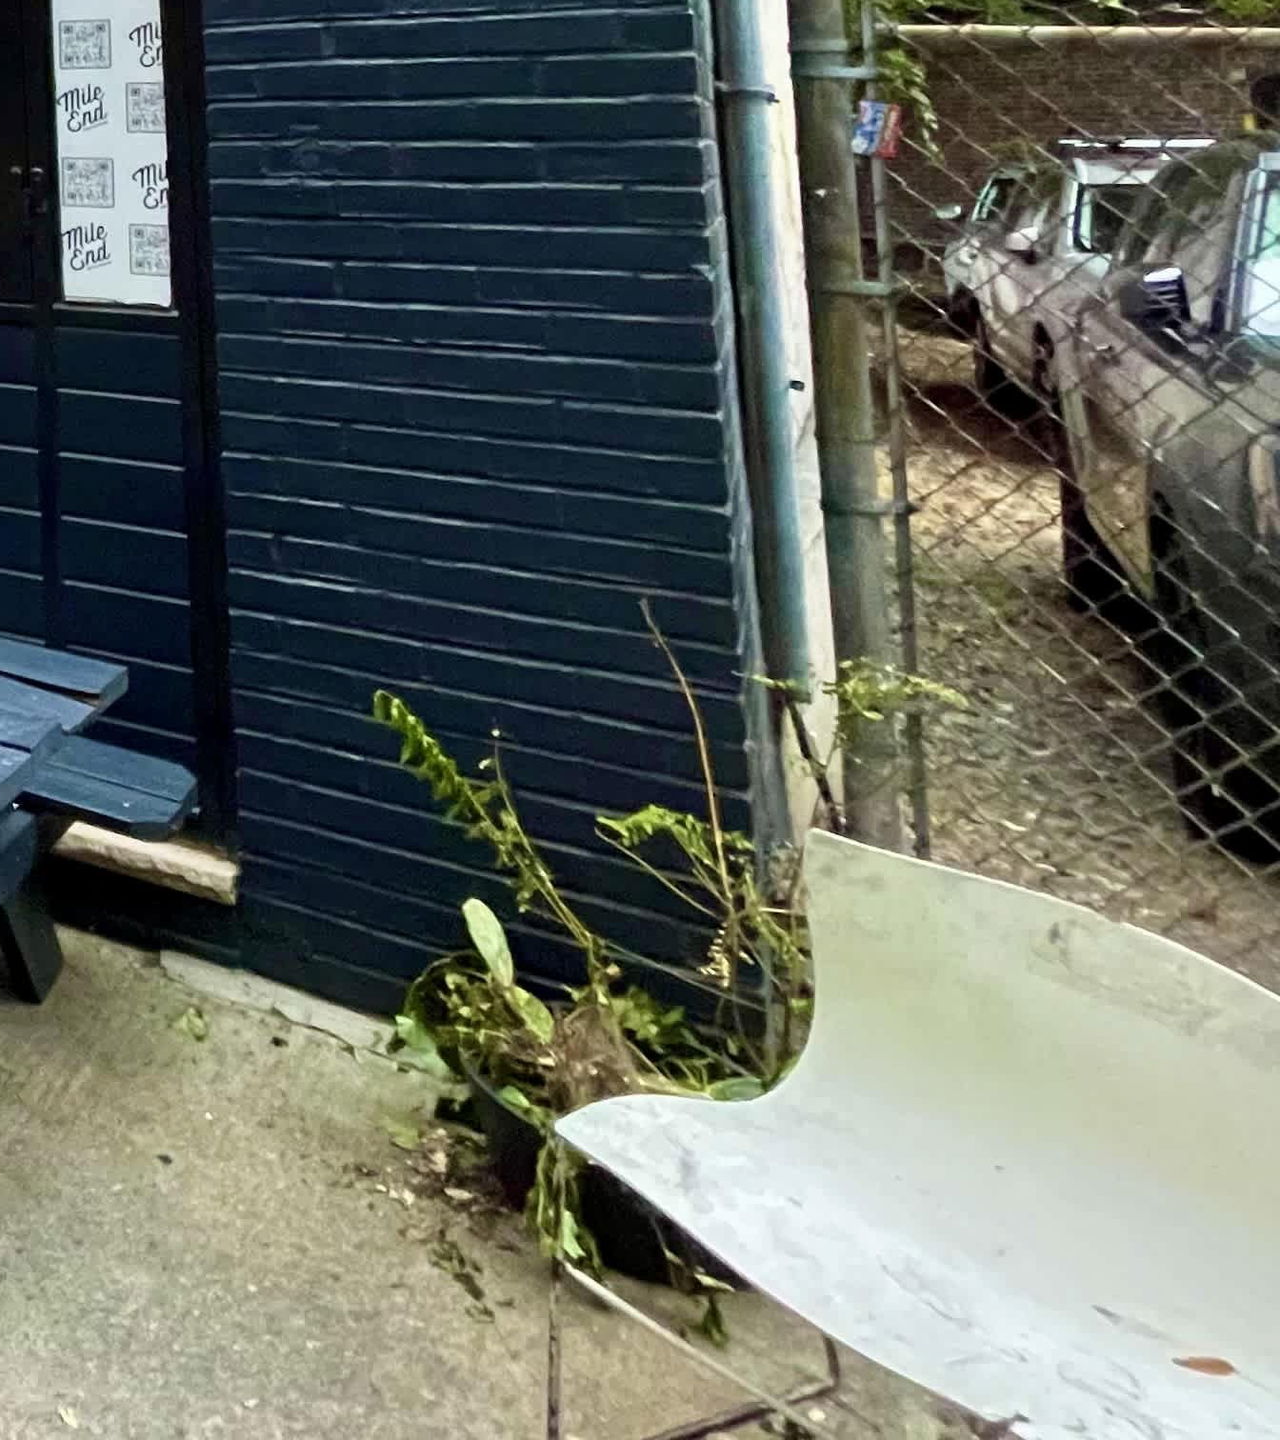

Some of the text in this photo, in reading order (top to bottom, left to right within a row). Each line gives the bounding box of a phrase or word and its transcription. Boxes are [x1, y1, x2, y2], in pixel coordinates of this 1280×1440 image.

[58, 84, 104, 112] Mile
[67, 100, 106, 132] End
[62, 223, 107, 250] Mile
[70, 240, 110, 271] End
